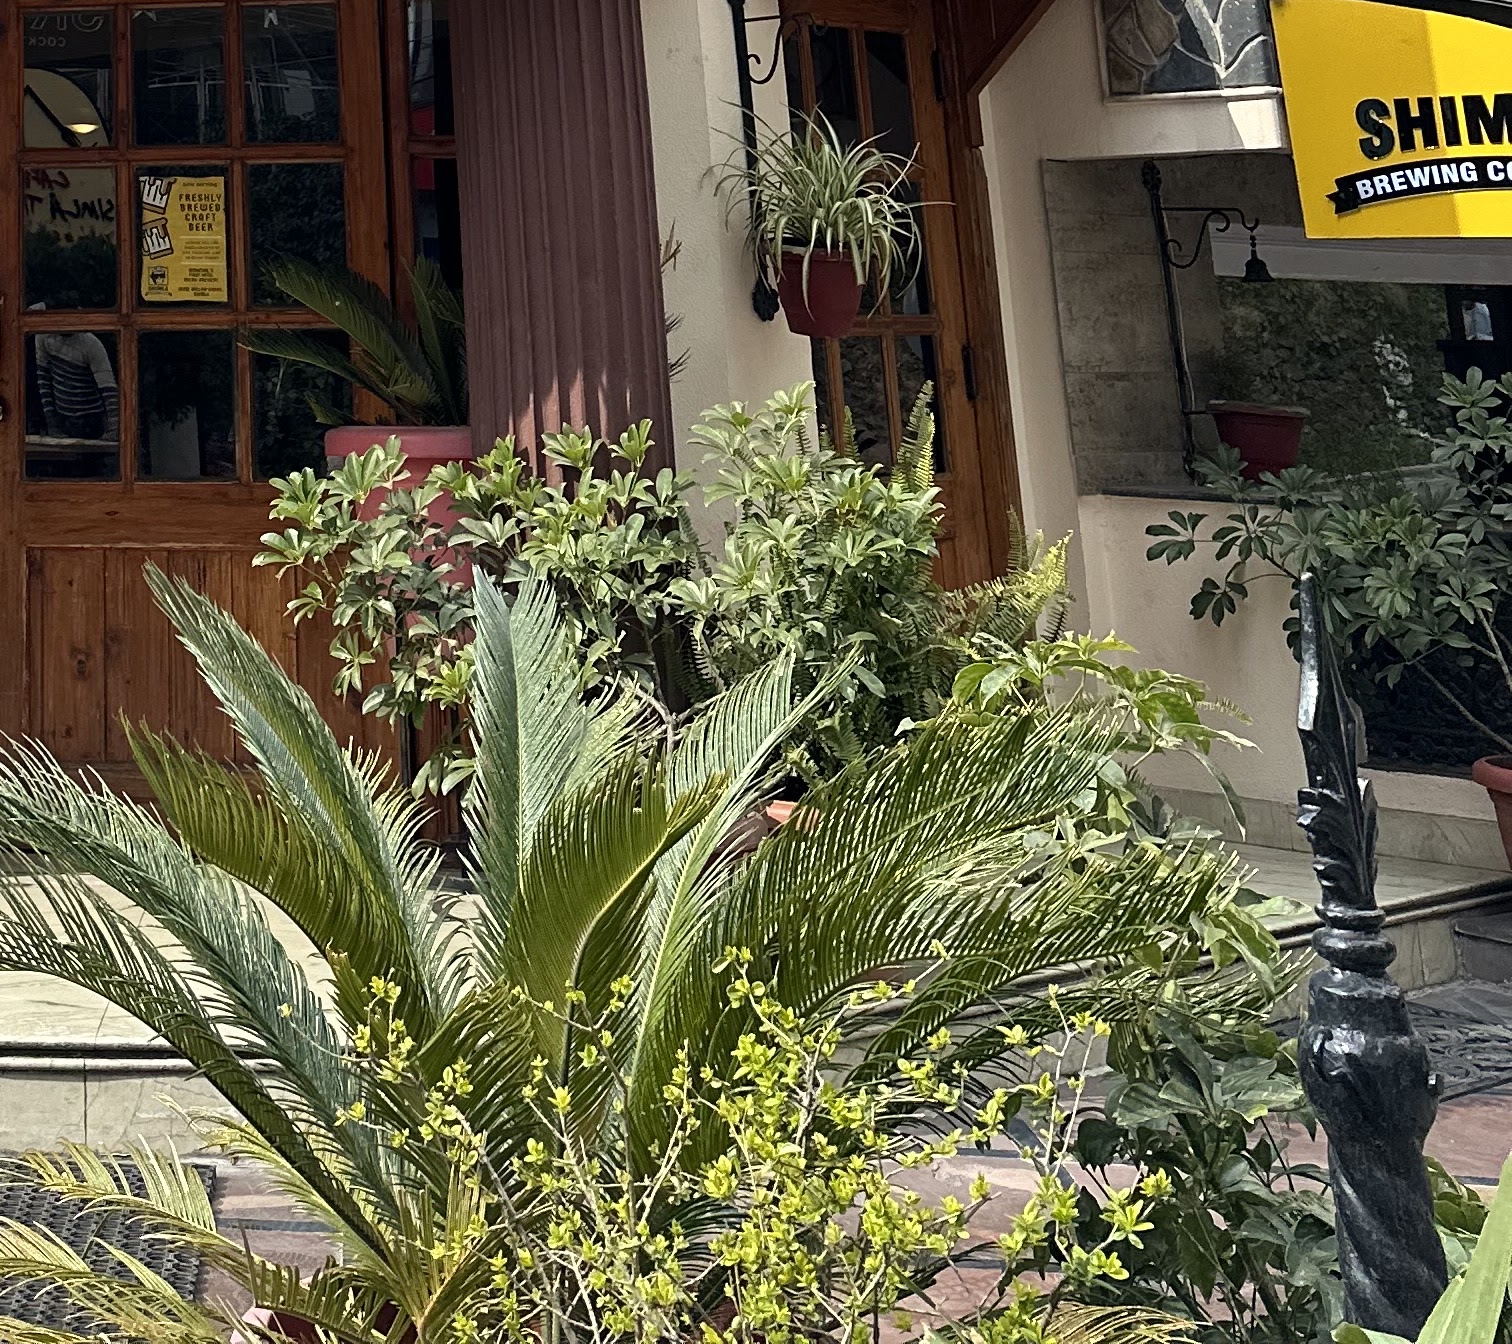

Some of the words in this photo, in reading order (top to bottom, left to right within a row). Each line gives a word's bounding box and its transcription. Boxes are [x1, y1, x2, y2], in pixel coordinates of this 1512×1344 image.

[1355, 162, 1478, 199] BREWING
[178, 193, 222, 202] FRESHLY
[179, 203, 221, 212] BREWED
[184, 213, 216, 222] CRAFT
[188, 223, 214, 232] BEER
